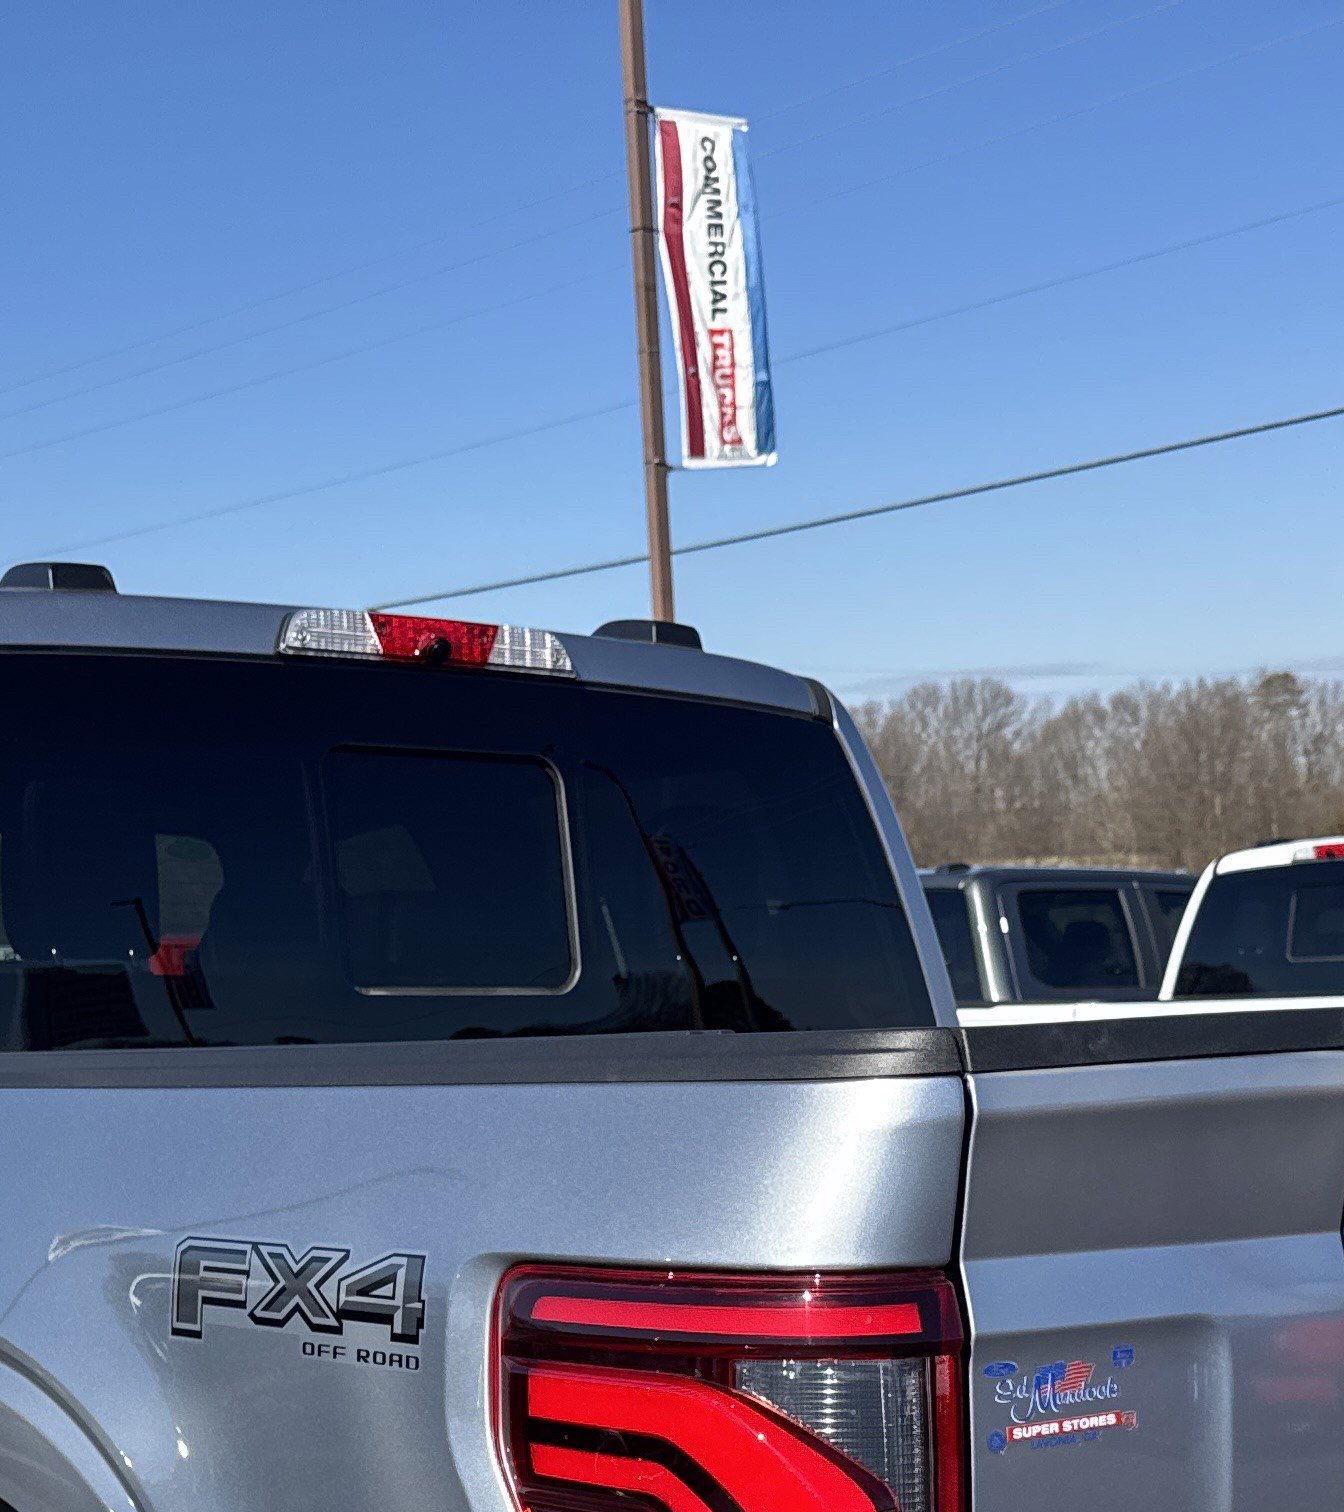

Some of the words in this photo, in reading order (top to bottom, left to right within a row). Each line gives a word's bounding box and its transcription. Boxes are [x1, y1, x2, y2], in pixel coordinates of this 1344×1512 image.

[701, 135, 727, 321] COMMERCIAL
[712, 330, 740, 443] TRUCKS
[171, 1236, 427, 1345] FX4
[302, 1341, 347, 1360] OFF
[356, 1349, 420, 1371] ROAD
[995, 1375, 1029, 1404] Ed
[1012, 1422, 1060, 1440] SUPER
[1062, 1413, 1117, 1432] STORES
